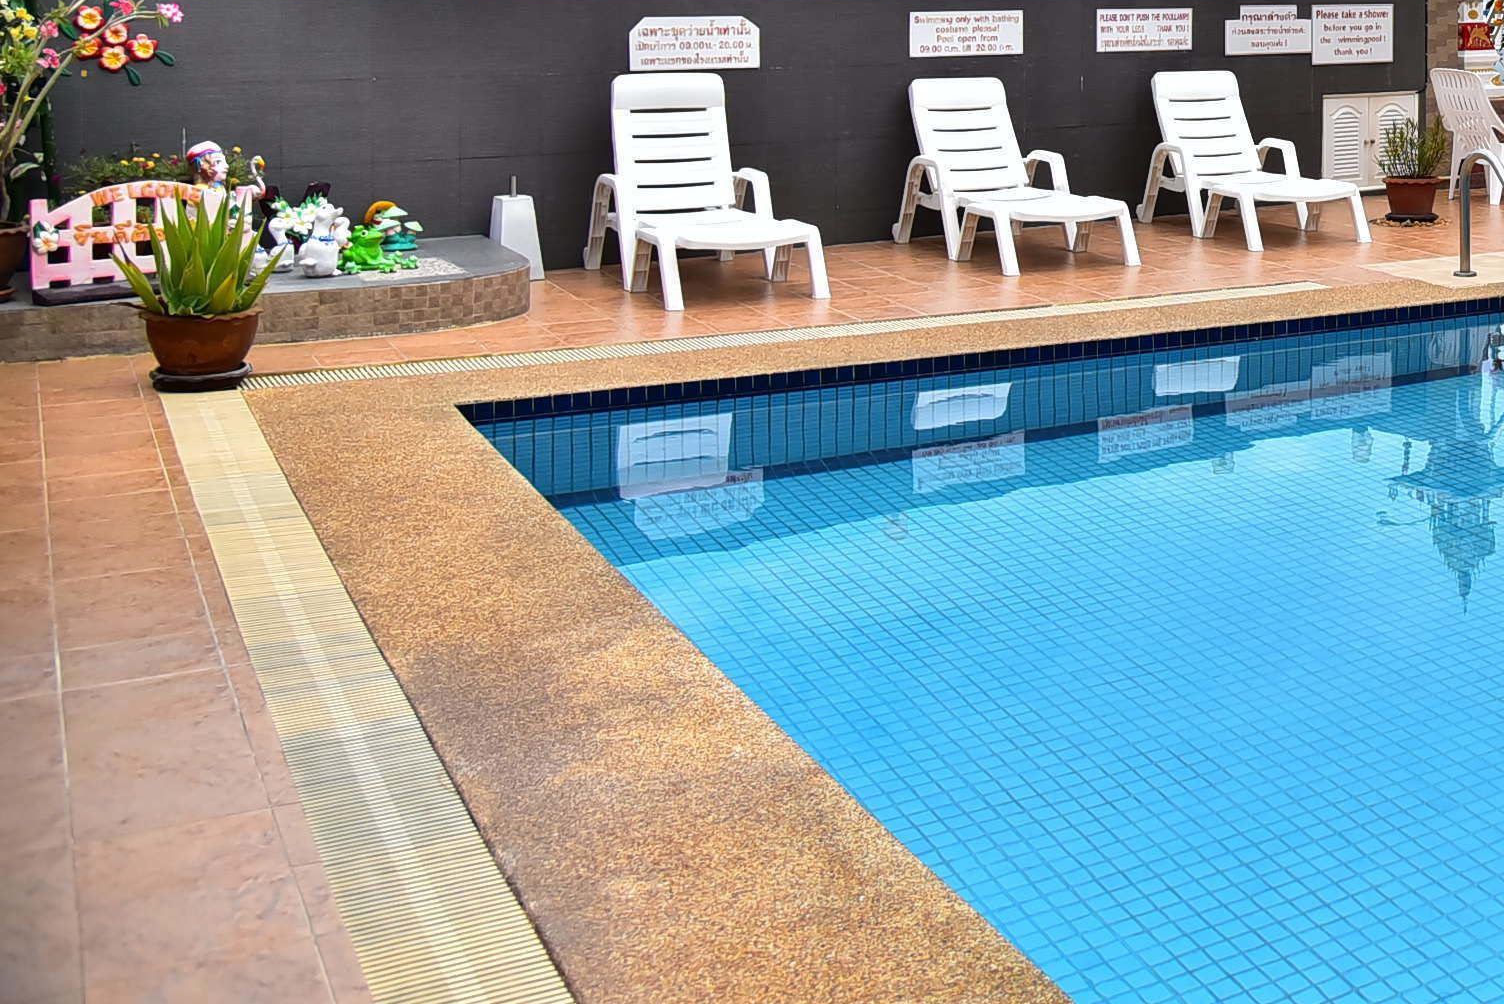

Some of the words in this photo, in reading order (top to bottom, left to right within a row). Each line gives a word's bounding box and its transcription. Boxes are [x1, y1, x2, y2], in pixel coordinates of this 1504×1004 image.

[1100, 13, 1118, 22] PLEASE
[1119, 13, 1135, 22] DON'T
[1136, 13, 1150, 22] PUSH
[1151, 13, 1161, 21] THE
[1316, 10, 1338, 19] Please
[1342, 10, 1356, 18] take
[1364, 9, 1389, 19] shower
[914, 15, 954, 26] Swimming
[955, 15, 971, 25] only
[974, 14, 990, 23] with
[992, 14, 1020, 24] bathing
[936, 26, 968, 34] costume
[972, 24, 1000, 33] please!
[1100, 25, 1114, 34] WITH
[1116, 25, 1130, 34] YOUR
[1131, 25, 1145, 33] LEGS
[1157, 24, 1172, 33] THANK
[1175, 24, 1186, 33] YOU
[1323, 23, 1346, 32] before
[1349, 24, 1362, 32] you
[1365, 24, 1374, 33] go
[1376, 22, 1382, 30] in
[937, 34, 954, 44] Pool
[957, 35, 977, 44] open
[980, 34, 999, 42] from
[1320, 36, 1332, 44] the
[1334, 47, 1353, 56] thank
[1355, 48, 1369, 57] you
[90, 182, 202, 206] WELCOME
